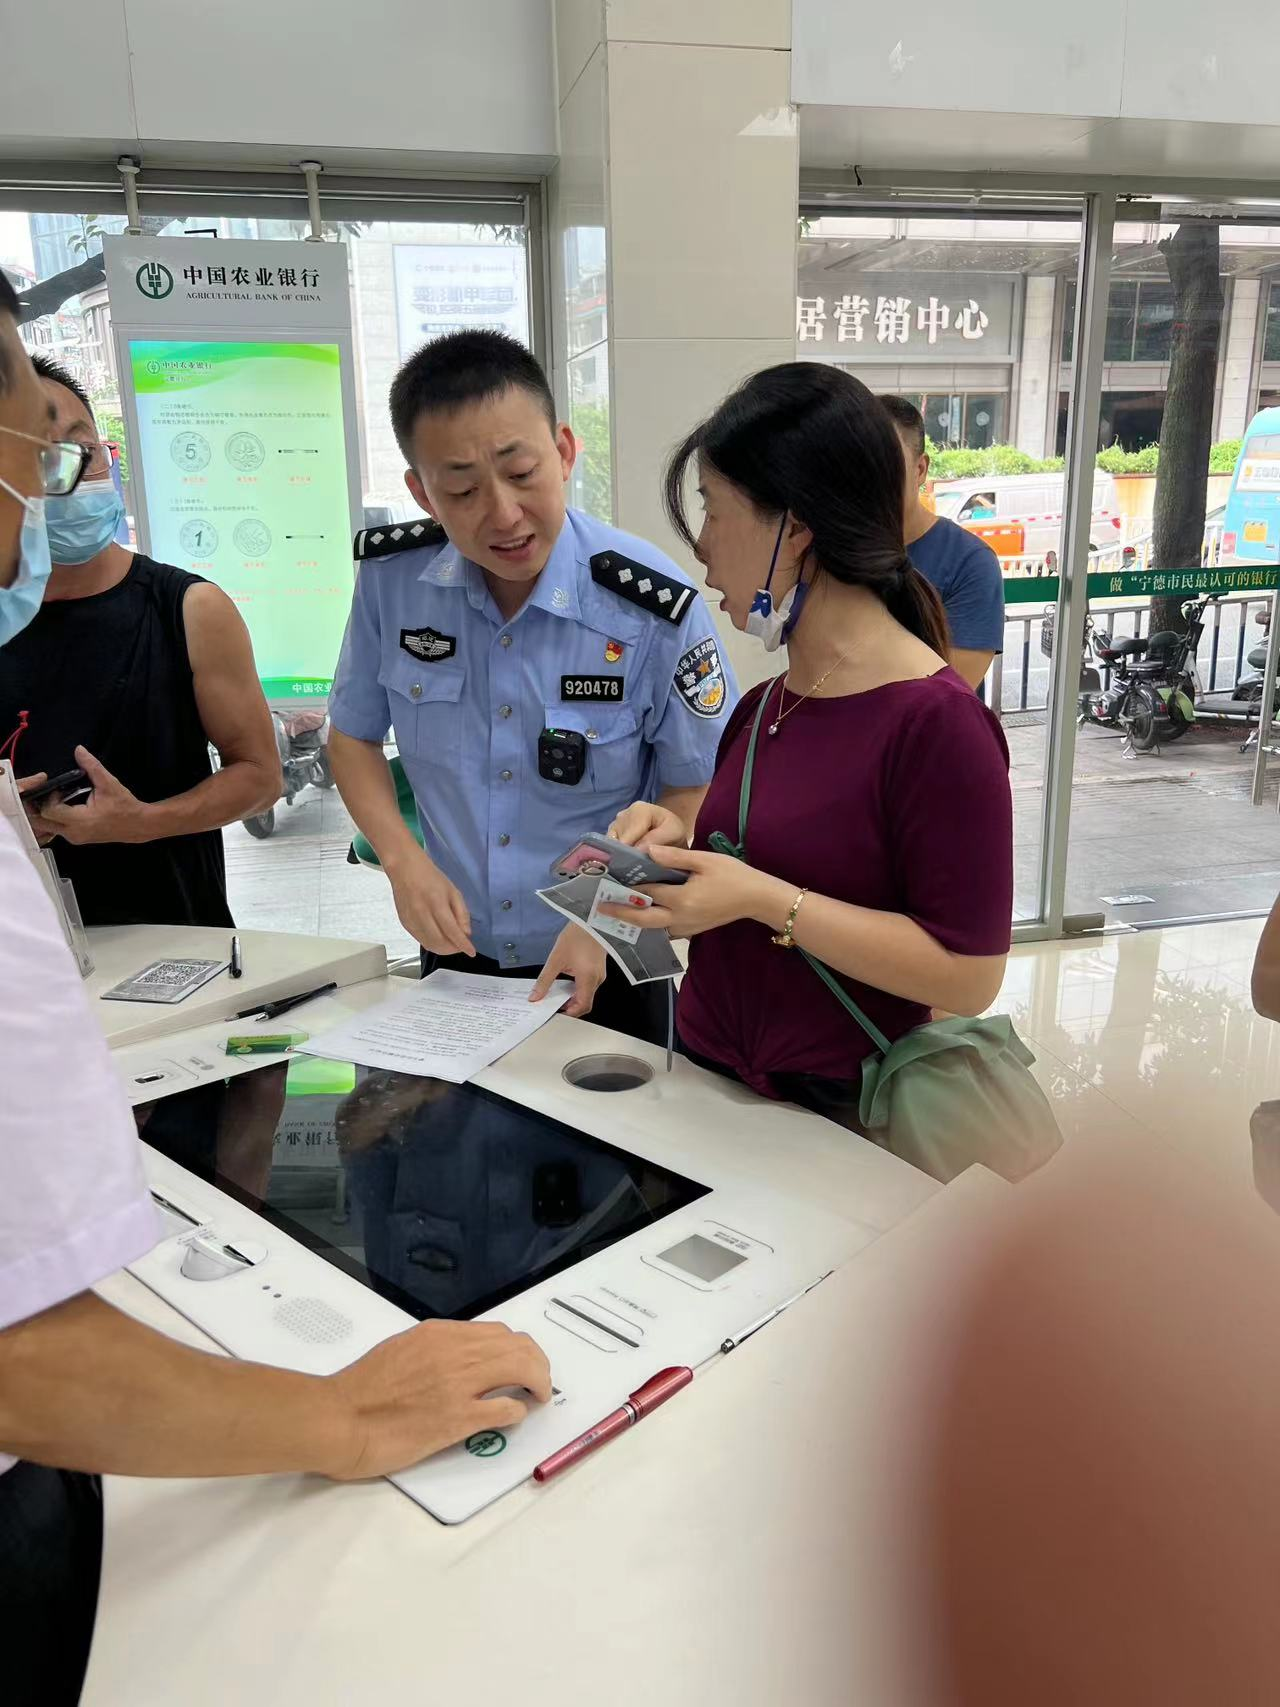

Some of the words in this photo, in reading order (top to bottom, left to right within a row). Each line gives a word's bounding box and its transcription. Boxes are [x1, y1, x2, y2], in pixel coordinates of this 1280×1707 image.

[183, 265, 320, 288] 中国农业银行
[186, 292, 252, 301] AGRICULTURAL
[255, 293, 279, 301] BANK
[295, 294, 321, 302] CHINA
[796, 295, 990, 344] 居营销中心
[185, 443, 196, 460] 5
[195, 530, 203, 547] 1
[565, 680, 619, 696] 920478
